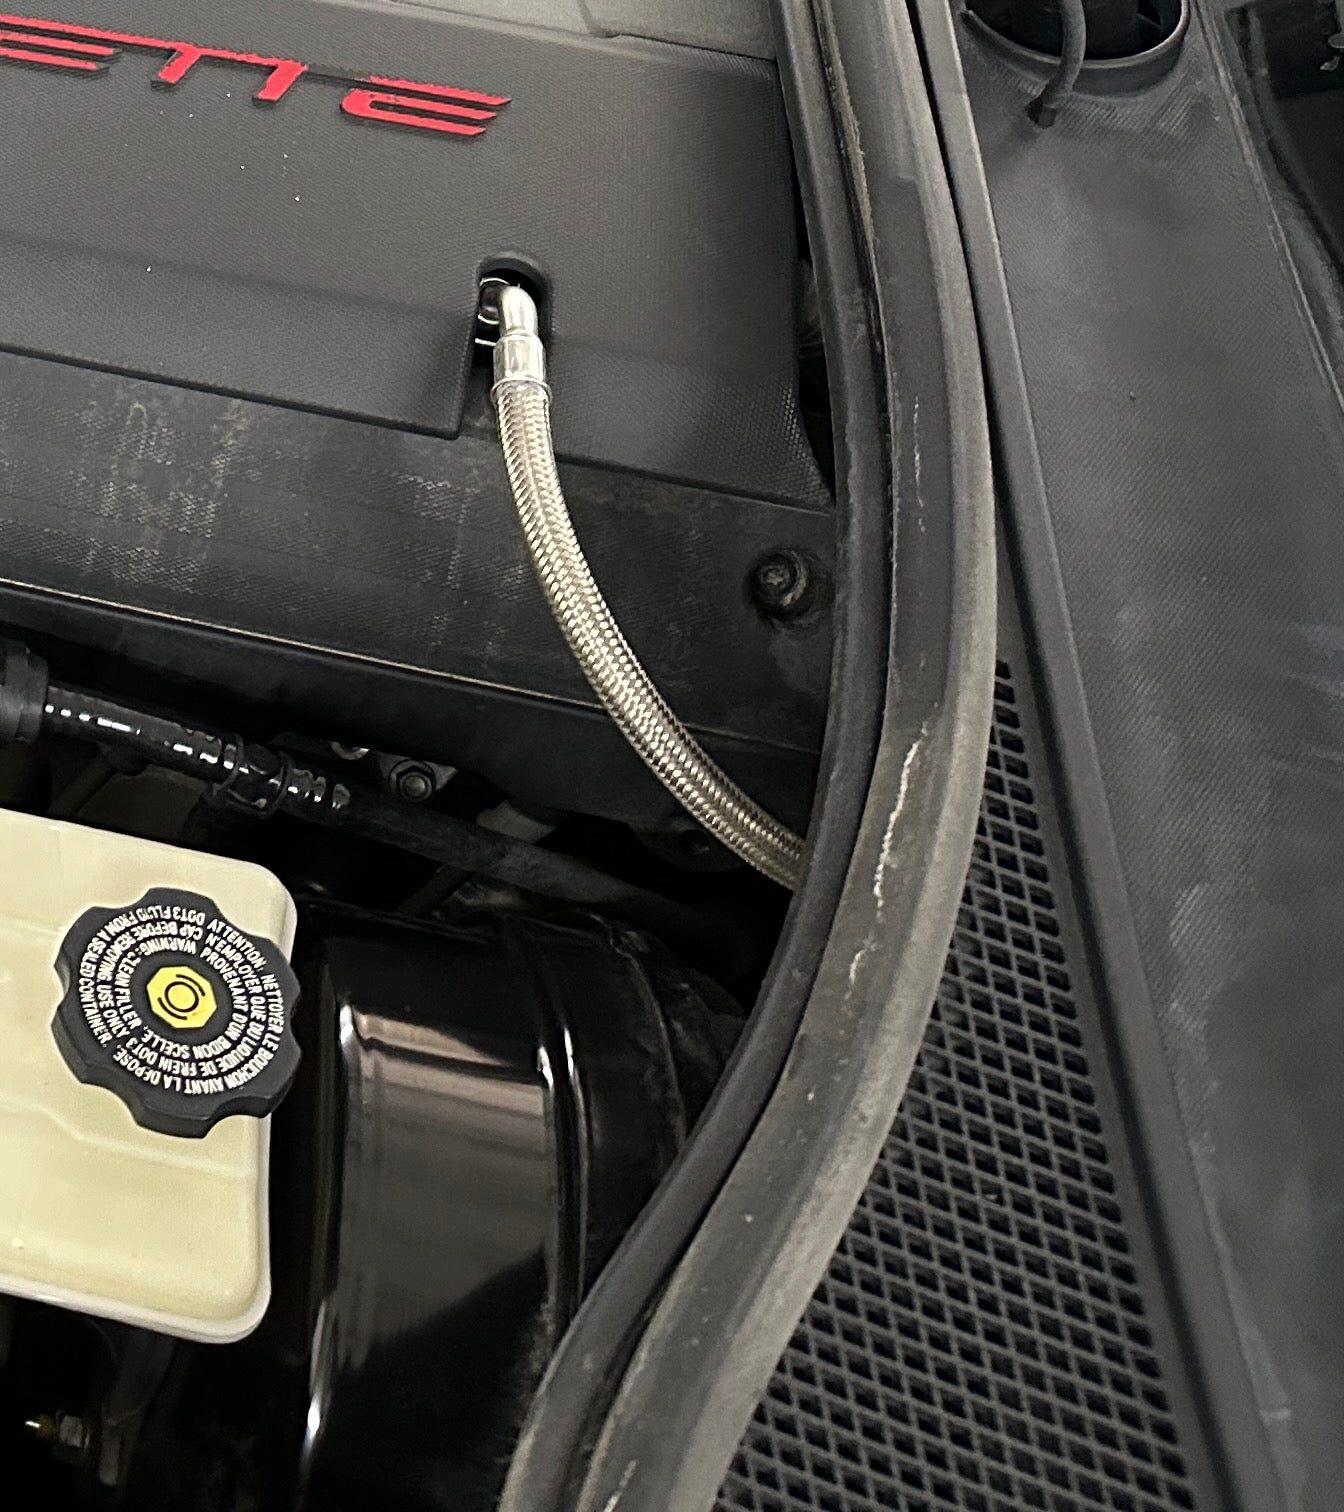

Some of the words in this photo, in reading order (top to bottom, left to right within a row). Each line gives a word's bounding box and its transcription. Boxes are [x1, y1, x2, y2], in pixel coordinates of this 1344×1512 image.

[104, 911, 138, 936] FROM
[173, 907, 205, 926] DOT3
[97, 930, 111, 941] A
[180, 924, 203, 940] CAP
[80, 937, 106, 977] SEALED
[115, 952, 141, 987] CLEAN
[205, 933, 262, 993] N'EMPLOYER
[200, 947, 248, 1011] PROVENANT
[97, 985, 114, 1008] USE
[115, 988, 142, 1029] FILLER
[250, 996, 266, 1021] QUE
[261, 974, 284, 1033] NETTOYER
[103, 1009, 130, 1037] ONLY
[247, 1022, 265, 1040] DU
[126, 1038, 158, 1065] DOT3
[192, 1036, 231, 1059] BIDON
[215, 1037, 257, 1072] LIQUIDE
[262, 1033, 280, 1051] LE
[158, 1056, 197, 1076] FREIN
[198, 1061, 218, 1076] DE
[224, 1047, 274, 1089] BOUCHON
[164, 1075, 181, 1091] LA
[184, 1077, 224, 1094] AVANT
